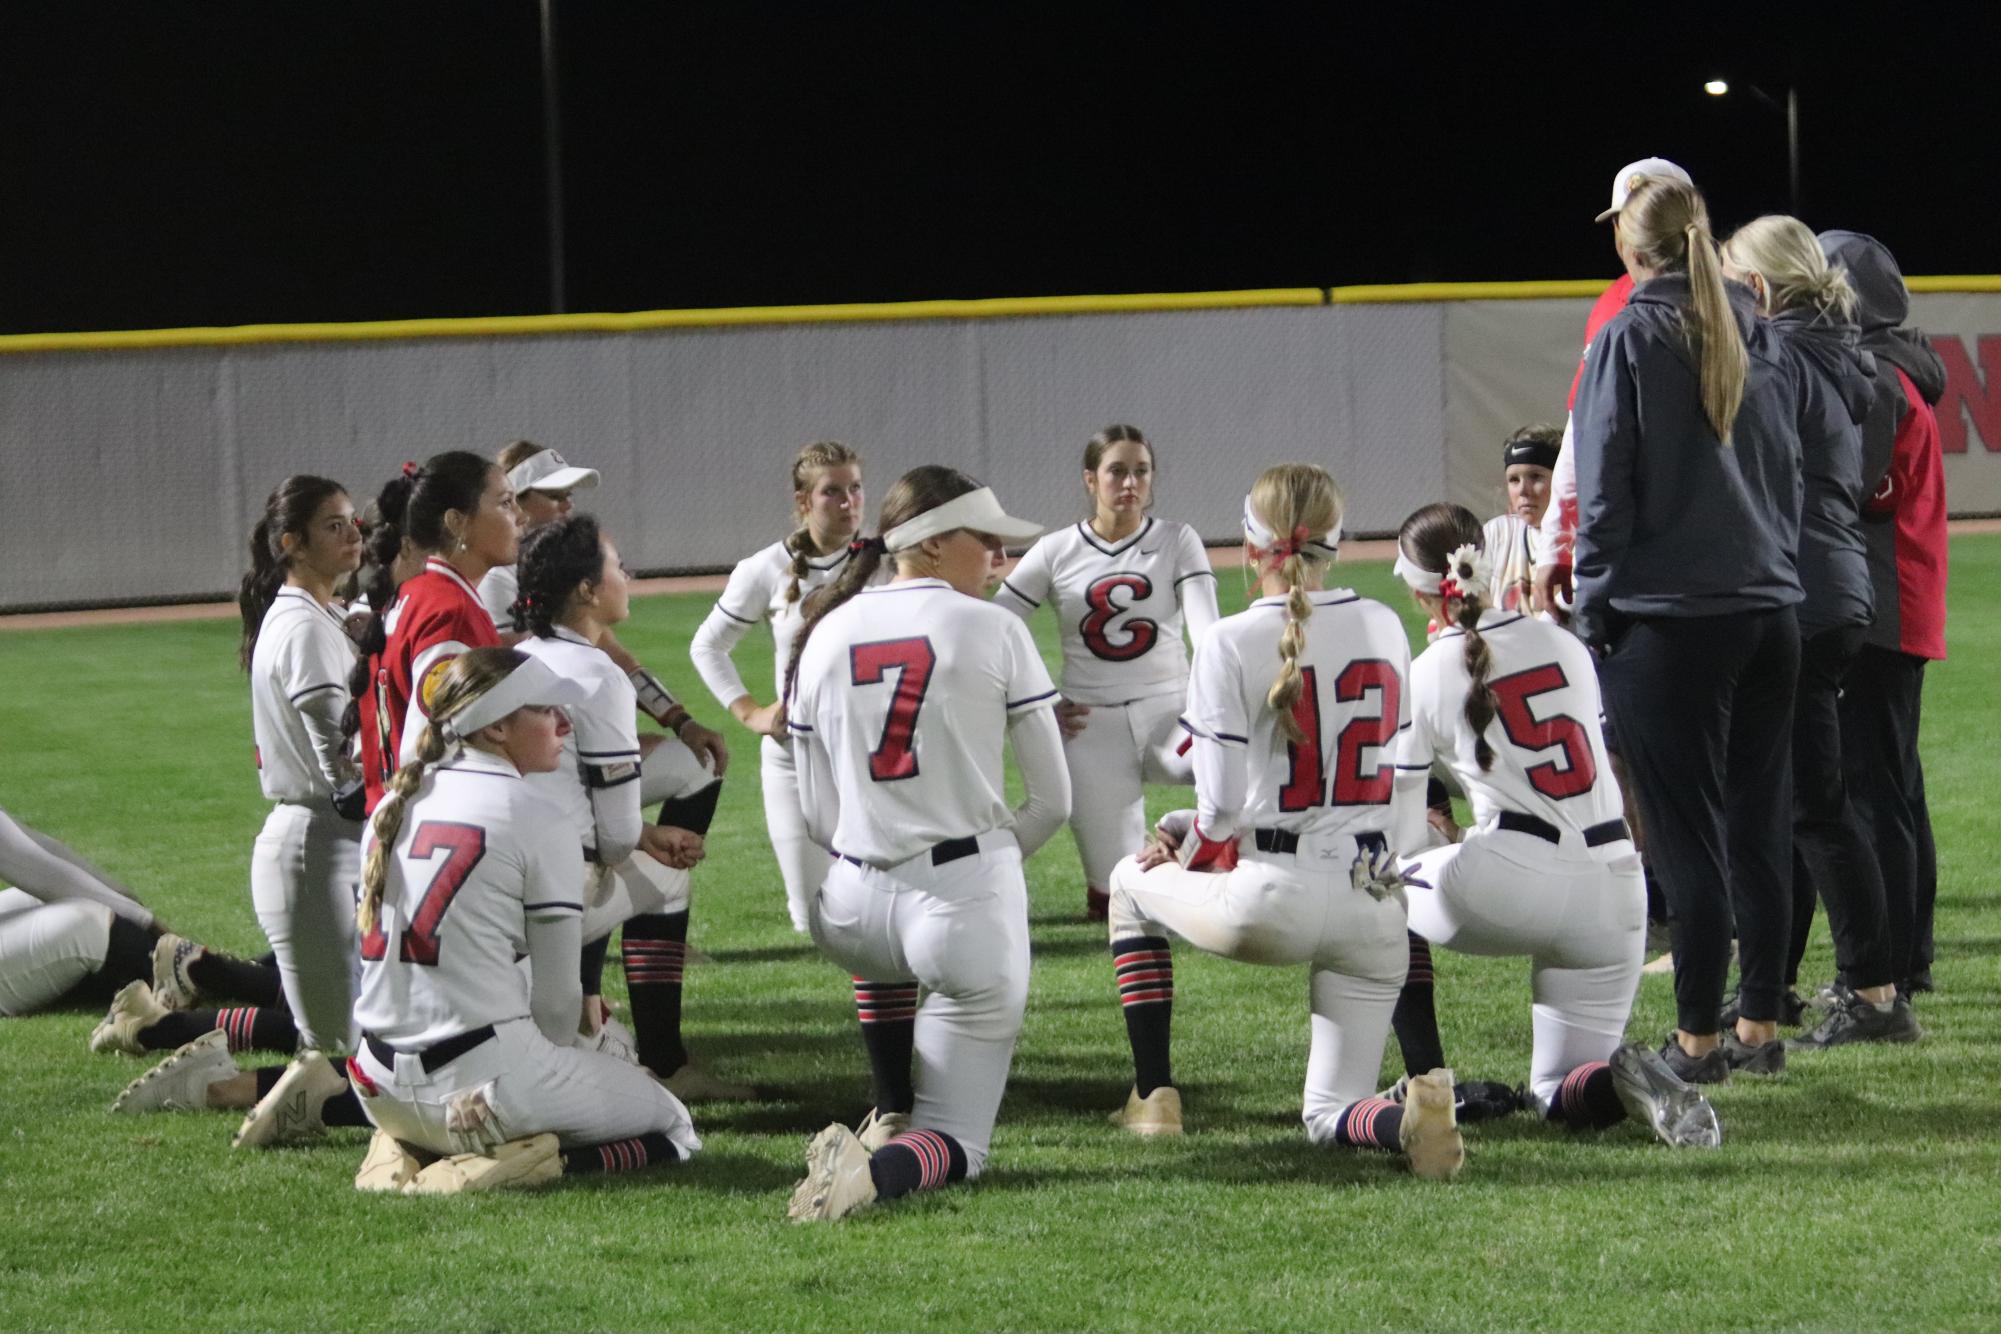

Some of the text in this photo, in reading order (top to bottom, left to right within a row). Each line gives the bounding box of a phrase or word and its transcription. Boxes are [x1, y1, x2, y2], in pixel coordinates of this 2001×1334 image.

[1079, 571, 1159, 662] E
[849, 634, 937, 782] 7
[1279, 658, 1402, 812] 12
[1486, 661, 1598, 801] 5
